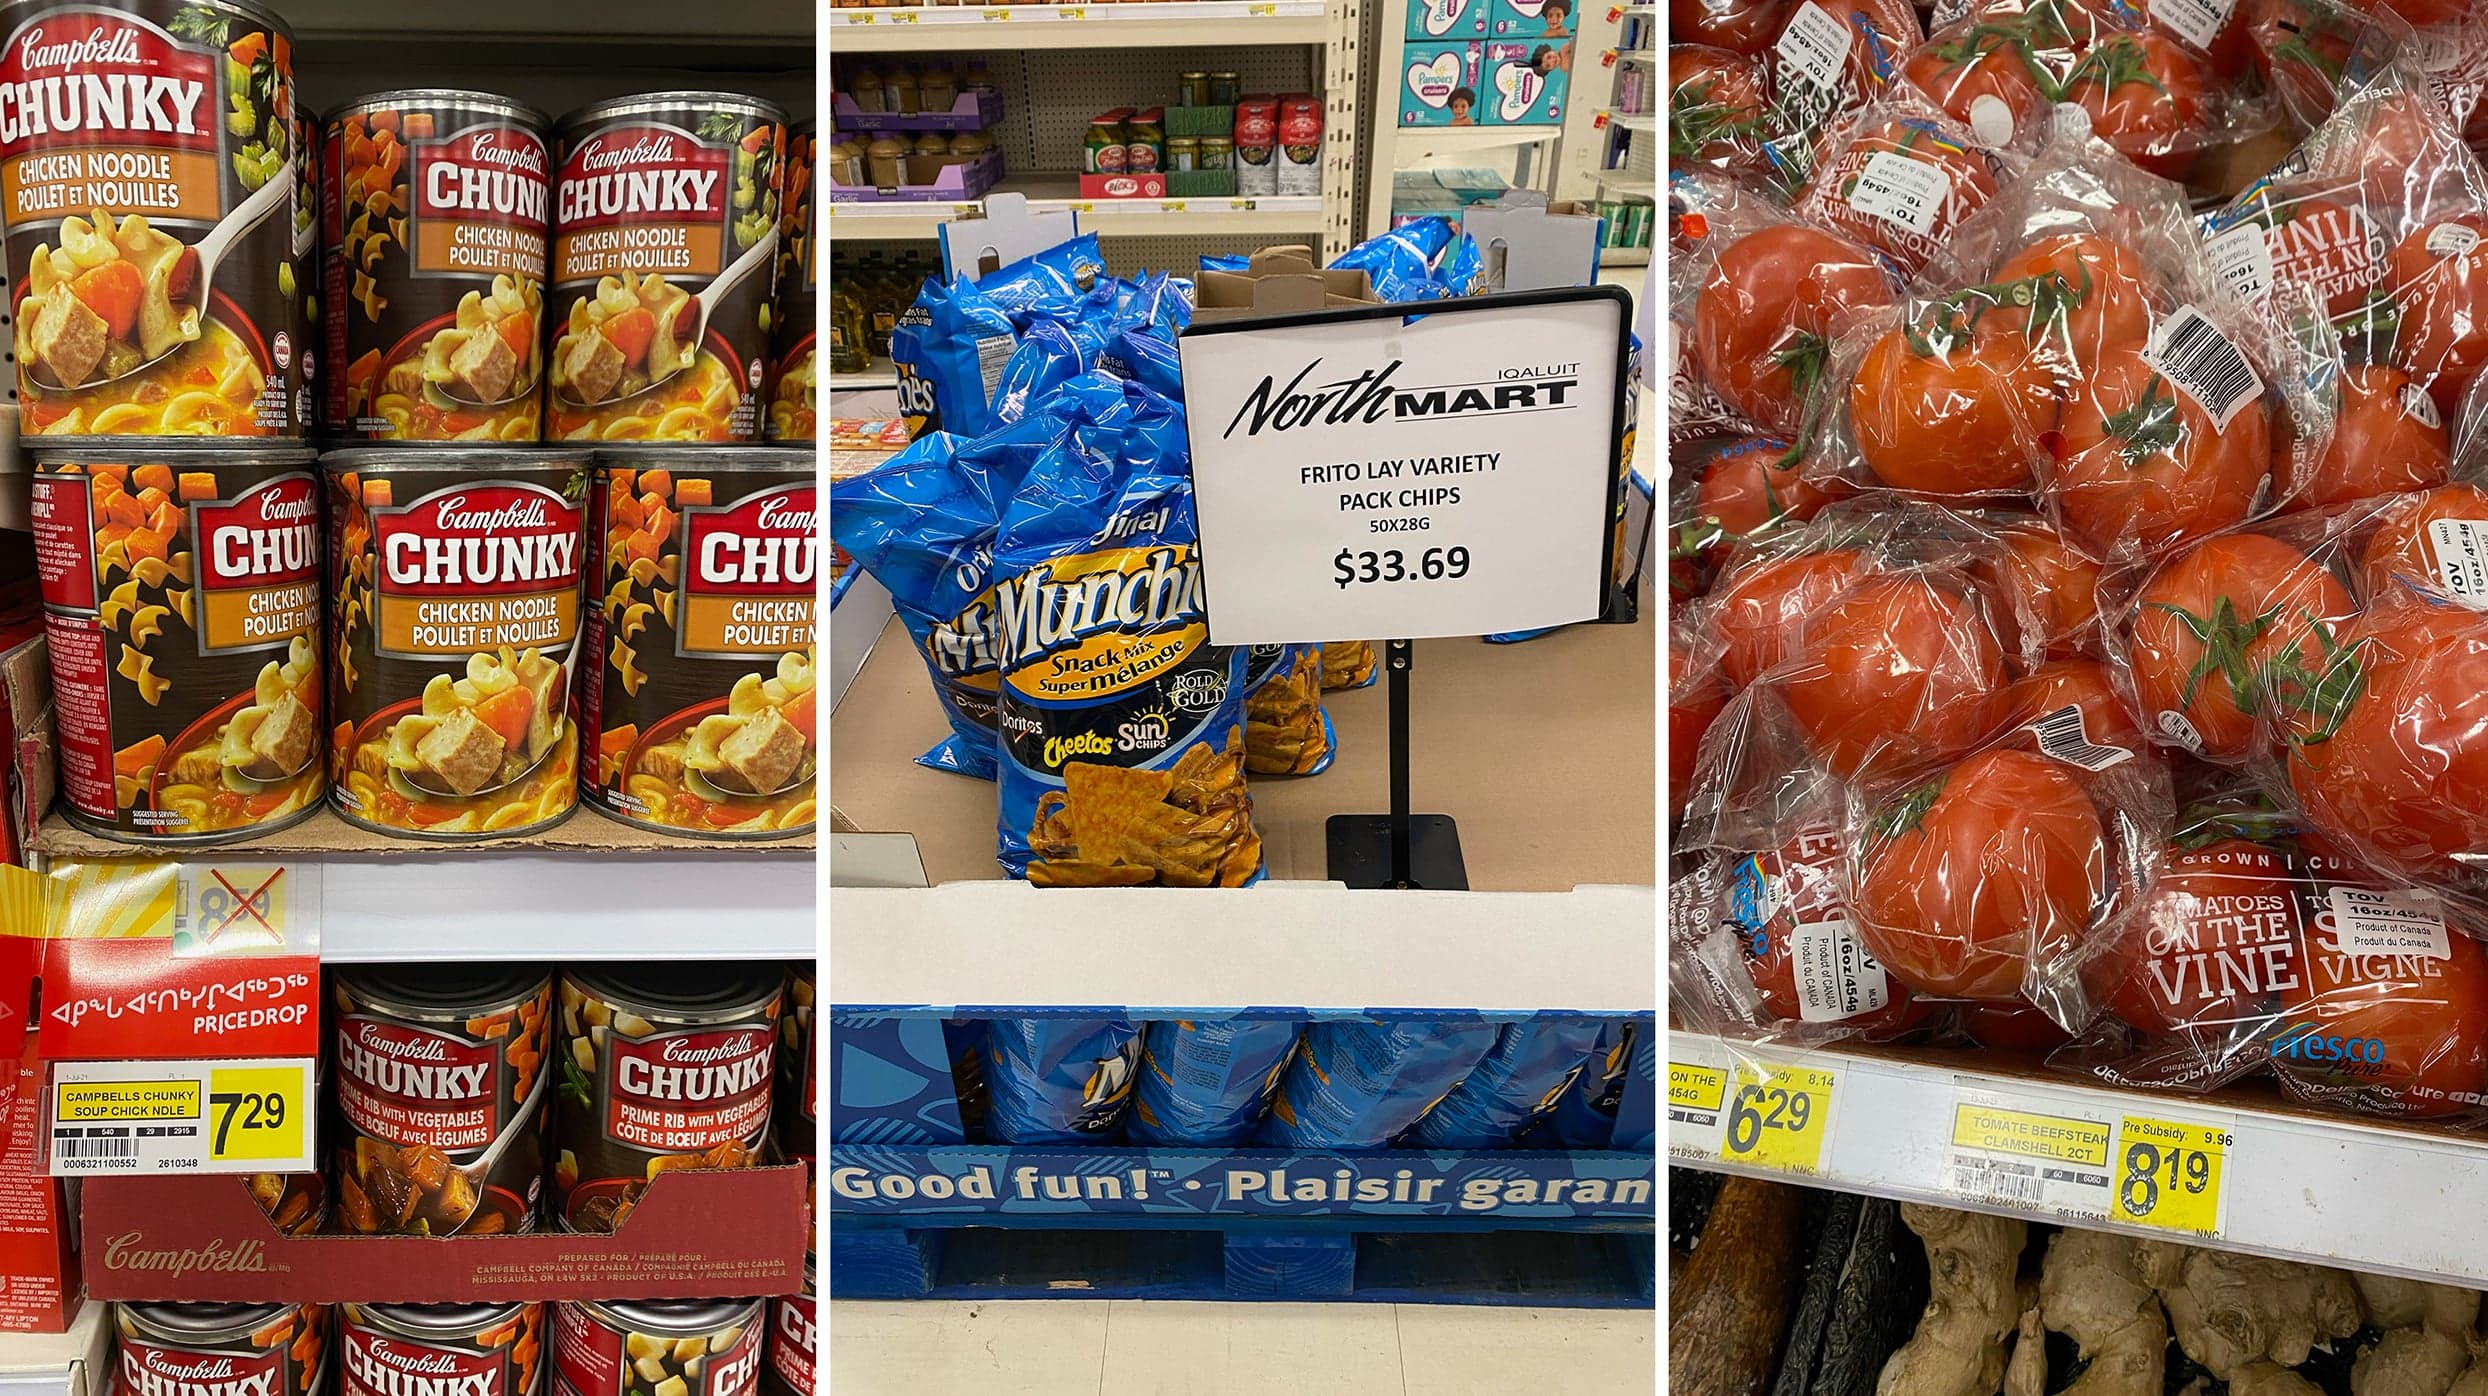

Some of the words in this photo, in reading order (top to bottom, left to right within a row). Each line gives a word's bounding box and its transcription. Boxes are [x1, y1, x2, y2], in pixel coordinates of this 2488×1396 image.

[22, 27, 142, 72] Campbell's
[1418, 72, 1453, 85] Pampers
[1805, 61, 1826, 81] TOV
[1509, 69, 1523, 109] Pampers
[0, 73, 203, 144] CHUNKY
[19, 155, 82, 183] CHICKEN
[88, 154, 171, 180] NOODLE
[471, 134, 542, 175] Campbell's
[583, 137, 673, 173] Campbell's
[17, 184, 65, 213] POULET
[69, 189, 83, 204] ET
[86, 182, 180, 209] NOUILLES
[558, 169, 718, 225] CHUNKY
[455, 225, 511, 250] CHICKEN
[570, 232, 618, 254] CHICKEN
[623, 228, 686, 247] NOODLE
[2262, 203, 2380, 265] VINE
[449, 247, 499, 268] POULET
[501, 252, 511, 267] ET
[566, 253, 604, 274] POULET
[607, 254, 618, 269] ET
[620, 248, 690, 268] NOUILLES
[2343, 235, 2386, 273] ON
[1497, 362, 1581, 380] IQALUIT
[2158, 359, 2189, 384] 79508
[2191, 384, 2217, 414] 11102
[1300, 462, 1361, 485] FRITO
[1366, 460, 1404, 480] LAY
[1410, 453, 1502, 477] VARIETY
[1340, 489, 1393, 512] PACK
[1398, 487, 1461, 508] CHIPS
[438, 496, 546, 535] Campbell's
[1369, 516, 1431, 533] 50X28G
[386, 531, 577, 585] CHUNKY
[1333, 545, 1471, 590] $33.69
[249, 588, 303, 614] CHICKEN
[418, 602, 493, 624] CHICKEN
[499, 596, 556, 621] NOODLE
[732, 601, 808, 622] CHICKEN
[244, 612, 294, 637] POULET
[296, 612, 304, 627] ET
[412, 624, 476, 647] POULET
[479, 630, 491, 644] ET
[496, 617, 559, 643] NOUILLES
[723, 624, 789, 645] POULET
[791, 627, 805, 643] ET
[1038, 678, 1089, 695] Super
[1089, 640, 1185, 692] mélange
[1051, 649, 1120, 678] Snack
[1122, 641, 1156, 662] Mix
[1173, 674, 1214, 690] ROLD
[1175, 686, 1228, 708] GOLD
[1002, 712, 1043, 735] Doritos
[1117, 715, 1167, 751] Sun
[1043, 728, 1114, 768] Cheetos
[1135, 739, 1167, 749] CHIPS
[2182, 852, 2271, 868] GROWN
[1732, 851, 1769, 955] Fresco
[2342, 890, 2386, 903] TOV
[2145, 925, 2199, 956] ON
[2206, 911, 2290, 948] THE
[2354, 936, 2385, 947] Produit
[2387, 937, 2398, 947] du
[2399, 937, 2432, 949] Canada
[2355, 922, 2388, 932] Product
[2390, 924, 2399, 933] of
[2399, 925, 2432, 936] Canada
[1800, 936, 1812, 966] Produit
[1818, 937, 1831, 969] Product
[1839, 936, 1858, 1013] 16oz/454g
[2147, 941, 2299, 1005] VINE
[2318, 953, 2442, 985] VIGNE
[1805, 976, 1820, 1008] CANADA
[1822, 976, 1837, 1010] CANADA
[193, 1011, 248, 1035] PRICE
[250, 1004, 308, 1026] DROP
[360, 1023, 447, 1063] Campbell's
[663, 1033, 752, 1066] Campbell's
[2270, 1034, 2385, 1064] Fresco
[339, 1029, 489, 1100] CHUNKY
[619, 1043, 773, 1100] CHUNKY
[1670, 1071, 1689, 1084] ON
[1692, 1074, 1717, 1087] THE
[1669, 1087, 1699, 1100] 454G
[1808, 1074, 1835, 1088] 8.14
[66, 1092, 140, 1102] CAMPBELLS
[143, 1091, 195, 1101] CHUNKY
[74, 1106, 108, 1117] SOUP
[111, 1106, 150, 1116] CHICK
[152, 1105, 185, 1116] NDLE
[364, 1095, 380, 1115] RIB
[382, 1104, 406, 1123] WITH
[408, 1109, 485, 1128] VEGETABLES
[621, 1104, 661, 1127] PRIME
[665, 1113, 686, 1129] RIB
[688, 1114, 714, 1127] WITH
[716, 1088, 768, 1125] VEGETABLES
[356, 1112, 365, 1125] DE
[402, 1130, 427, 1144] AVEC
[429, 1127, 488, 1146] LÉGUMES
[616, 1121, 648, 1144] CÔTE
[650, 1132, 664, 1145] DE
[666, 1130, 707, 1147] BŒUF
[708, 1128, 732, 1145] AVEC
[1973, 1116, 2029, 1135] TOMATE
[2031, 1125, 2110, 1146] BEEFSTEAK
[2122, 1120, 2142, 1135] Pre
[2143, 1123, 2188, 1143] Subsidy:
[2204, 1131, 2234, 1147] 9.96
[63, 1158, 137, 1168] 0006321100552
[158, 1159, 199, 1168] 2610348
[1983, 1135, 2063, 1157] CLAMSHELL
[2067, 1147, 2094, 1161] 2CT
[1792, 1164, 1816, 1177] NNC
[831, 1166, 996, 1201] Good
[1225, 1168, 1446, 1204] Plaisir
[1460, 1174, 1651, 1211] garan
[2195, 1228, 2221, 1241] NNC
[104, 1231, 268, 1279] Campbell's
[476, 1265, 526, 1274] CAMPBELL
[528, 1264, 574, 1273] COMPANY
[577, 1264, 589, 1272] OF
[592, 1263, 632, 1272] CANADA
[642, 1262, 691, 1271] COMPAGNIE
[692, 1261, 735, 1270] CAMPBELL
[751, 1258, 785, 1268] CANADA
[558, 1254, 608, 1263] PREPARED
[610, 1253, 629, 1262] FOR
[471, 1275, 538, 1285] MISSISSAUGA,
[540, 1274, 554, 1282] ON
[557, 1273, 577, 1282] L4W
[607, 1273, 650, 1281] PRODUCT
[653, 1273, 666, 1281] OF
[668, 1271, 696, 1281] U.S.A.
[706, 1270, 742, 1279] PRODUIT
[145, 1348, 234, 1380] Campbell's
[370, 1336, 457, 1373] Campbell's
[780, 1340, 810, 1376] PRIME
[800, 1378, 811, 1392] DE
